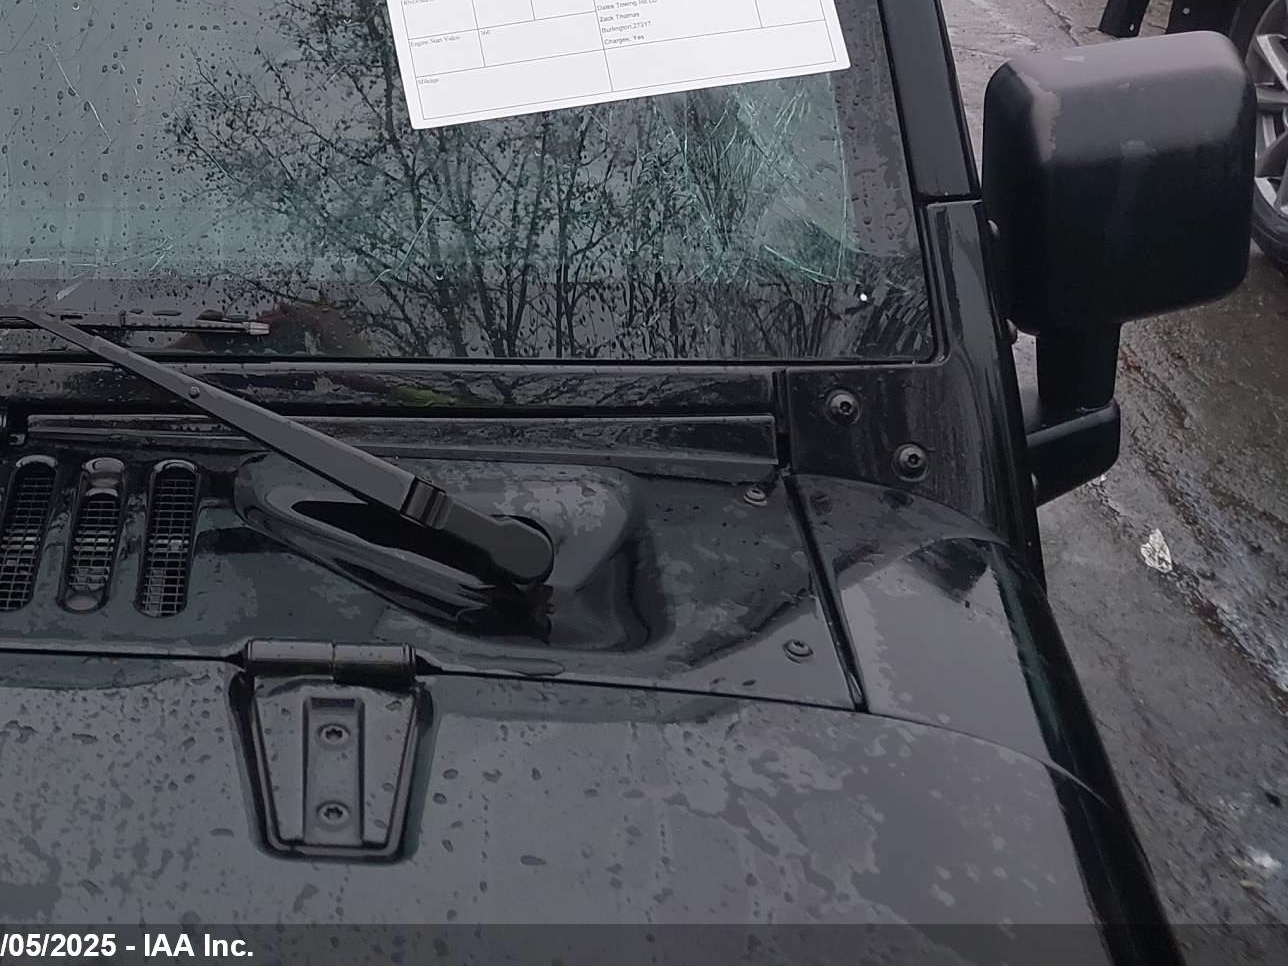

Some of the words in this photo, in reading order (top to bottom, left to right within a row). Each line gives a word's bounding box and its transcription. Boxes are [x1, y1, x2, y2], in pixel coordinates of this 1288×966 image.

[616, 0, 638, 9] Towing
[616, 12, 640, 20] Thomas
[604, 37, 631, 46] Charges:
